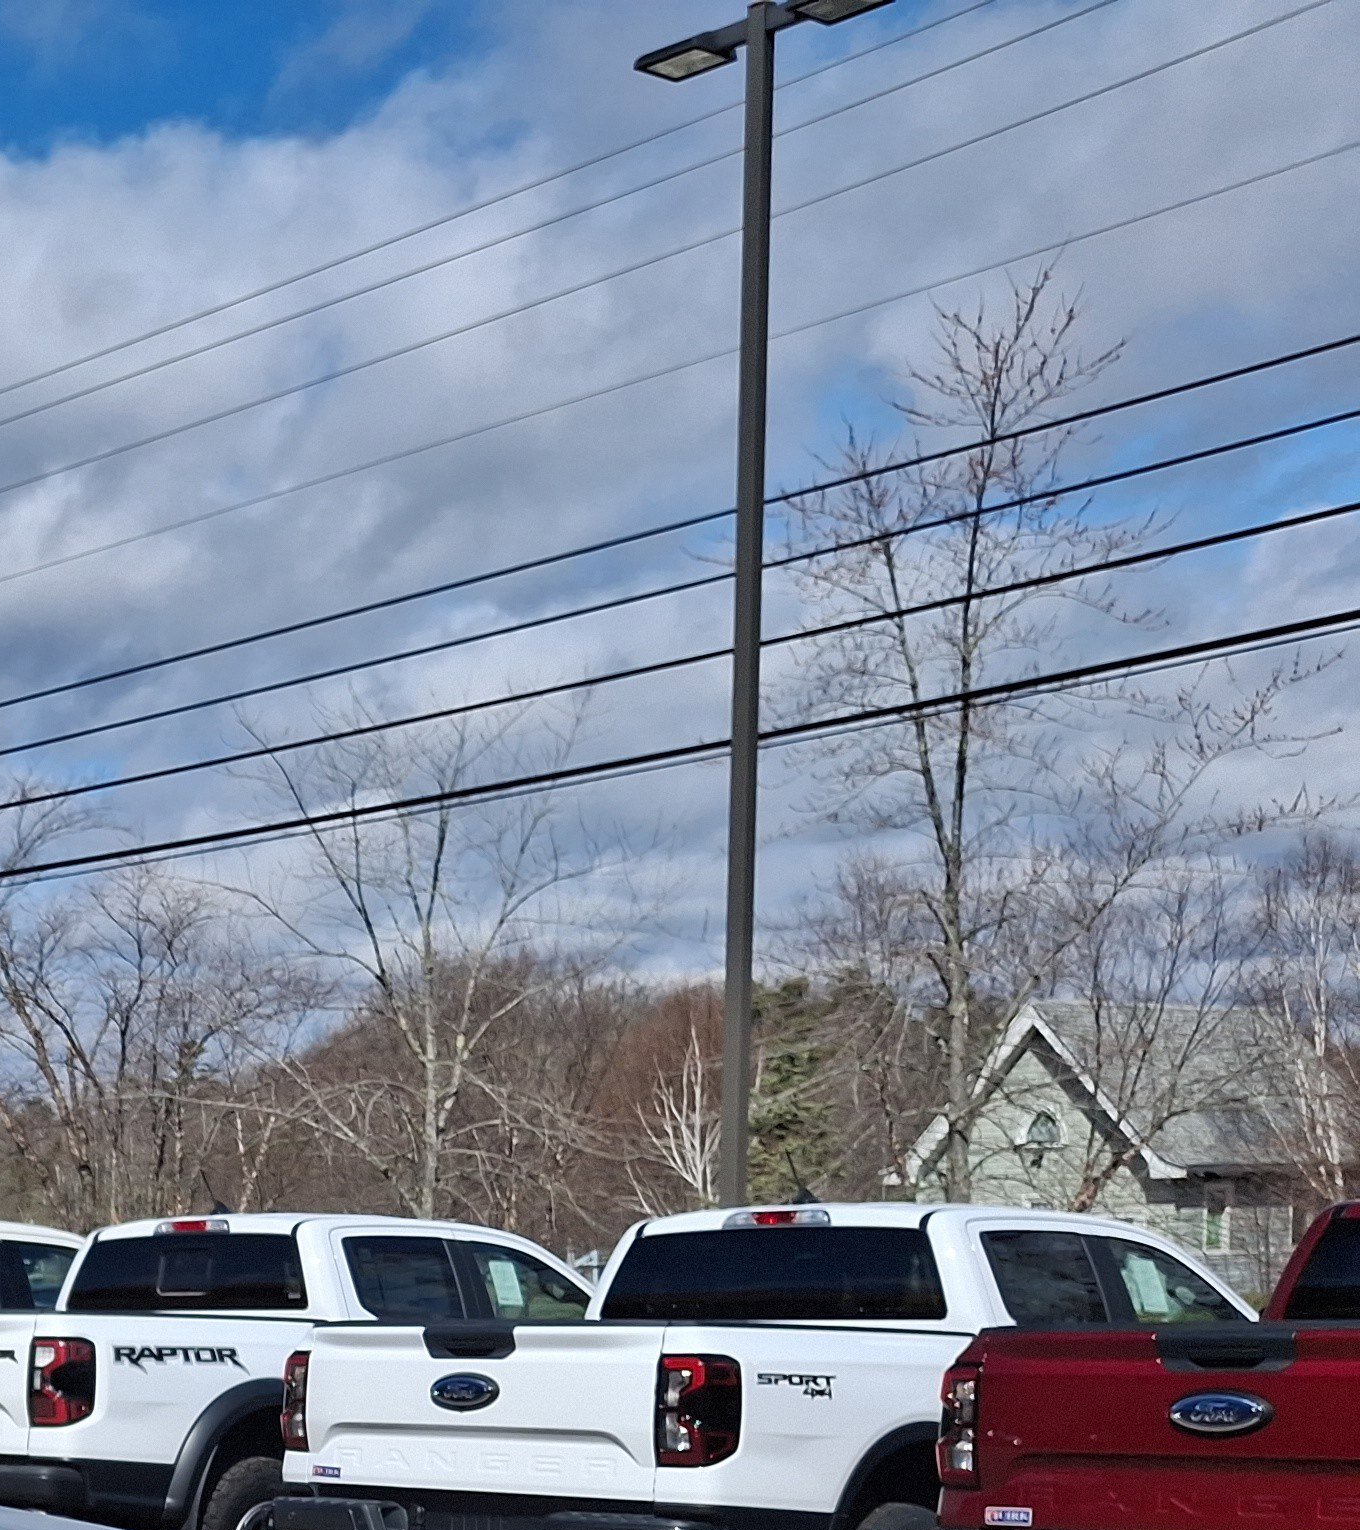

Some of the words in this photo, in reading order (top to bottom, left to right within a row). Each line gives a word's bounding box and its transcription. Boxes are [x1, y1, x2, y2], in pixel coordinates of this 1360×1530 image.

[113, 1346, 250, 1375] RAPTOR
[757, 1373, 836, 1386] SPORT
[332, 1446, 618, 1479] RANGER
